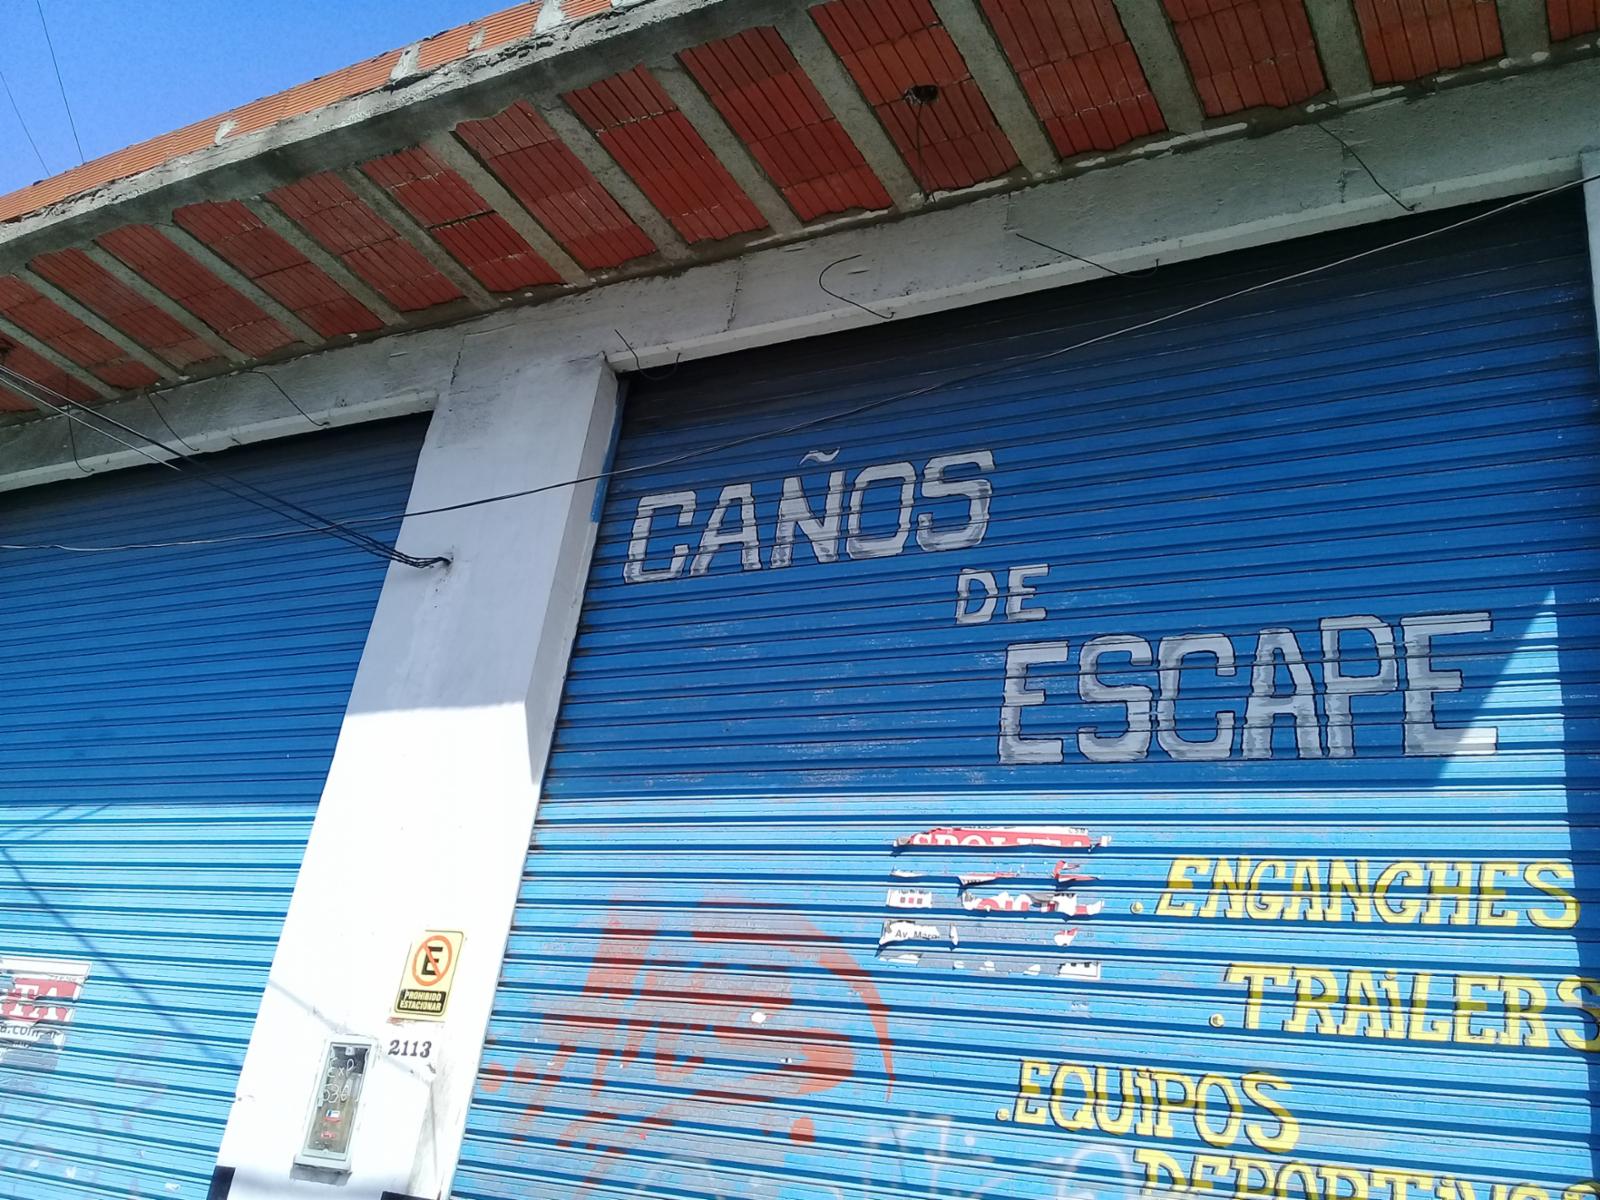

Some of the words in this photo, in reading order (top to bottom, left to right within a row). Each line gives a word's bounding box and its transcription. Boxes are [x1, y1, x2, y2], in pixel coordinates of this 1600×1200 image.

[623, 447, 996, 583] CAÑOS
[954, 563, 1050, 625] DE
[998, 611, 1498, 764] ESCAPE
[420, 946, 443, 975] E
[400, 1000, 442, 1011] ESTACIONAR
[404, 990, 441, 1001] PROHIBIDO
[388, 1040, 431, 1058] 2113
[1133, 1148, 1600, 1200] DEPORT
